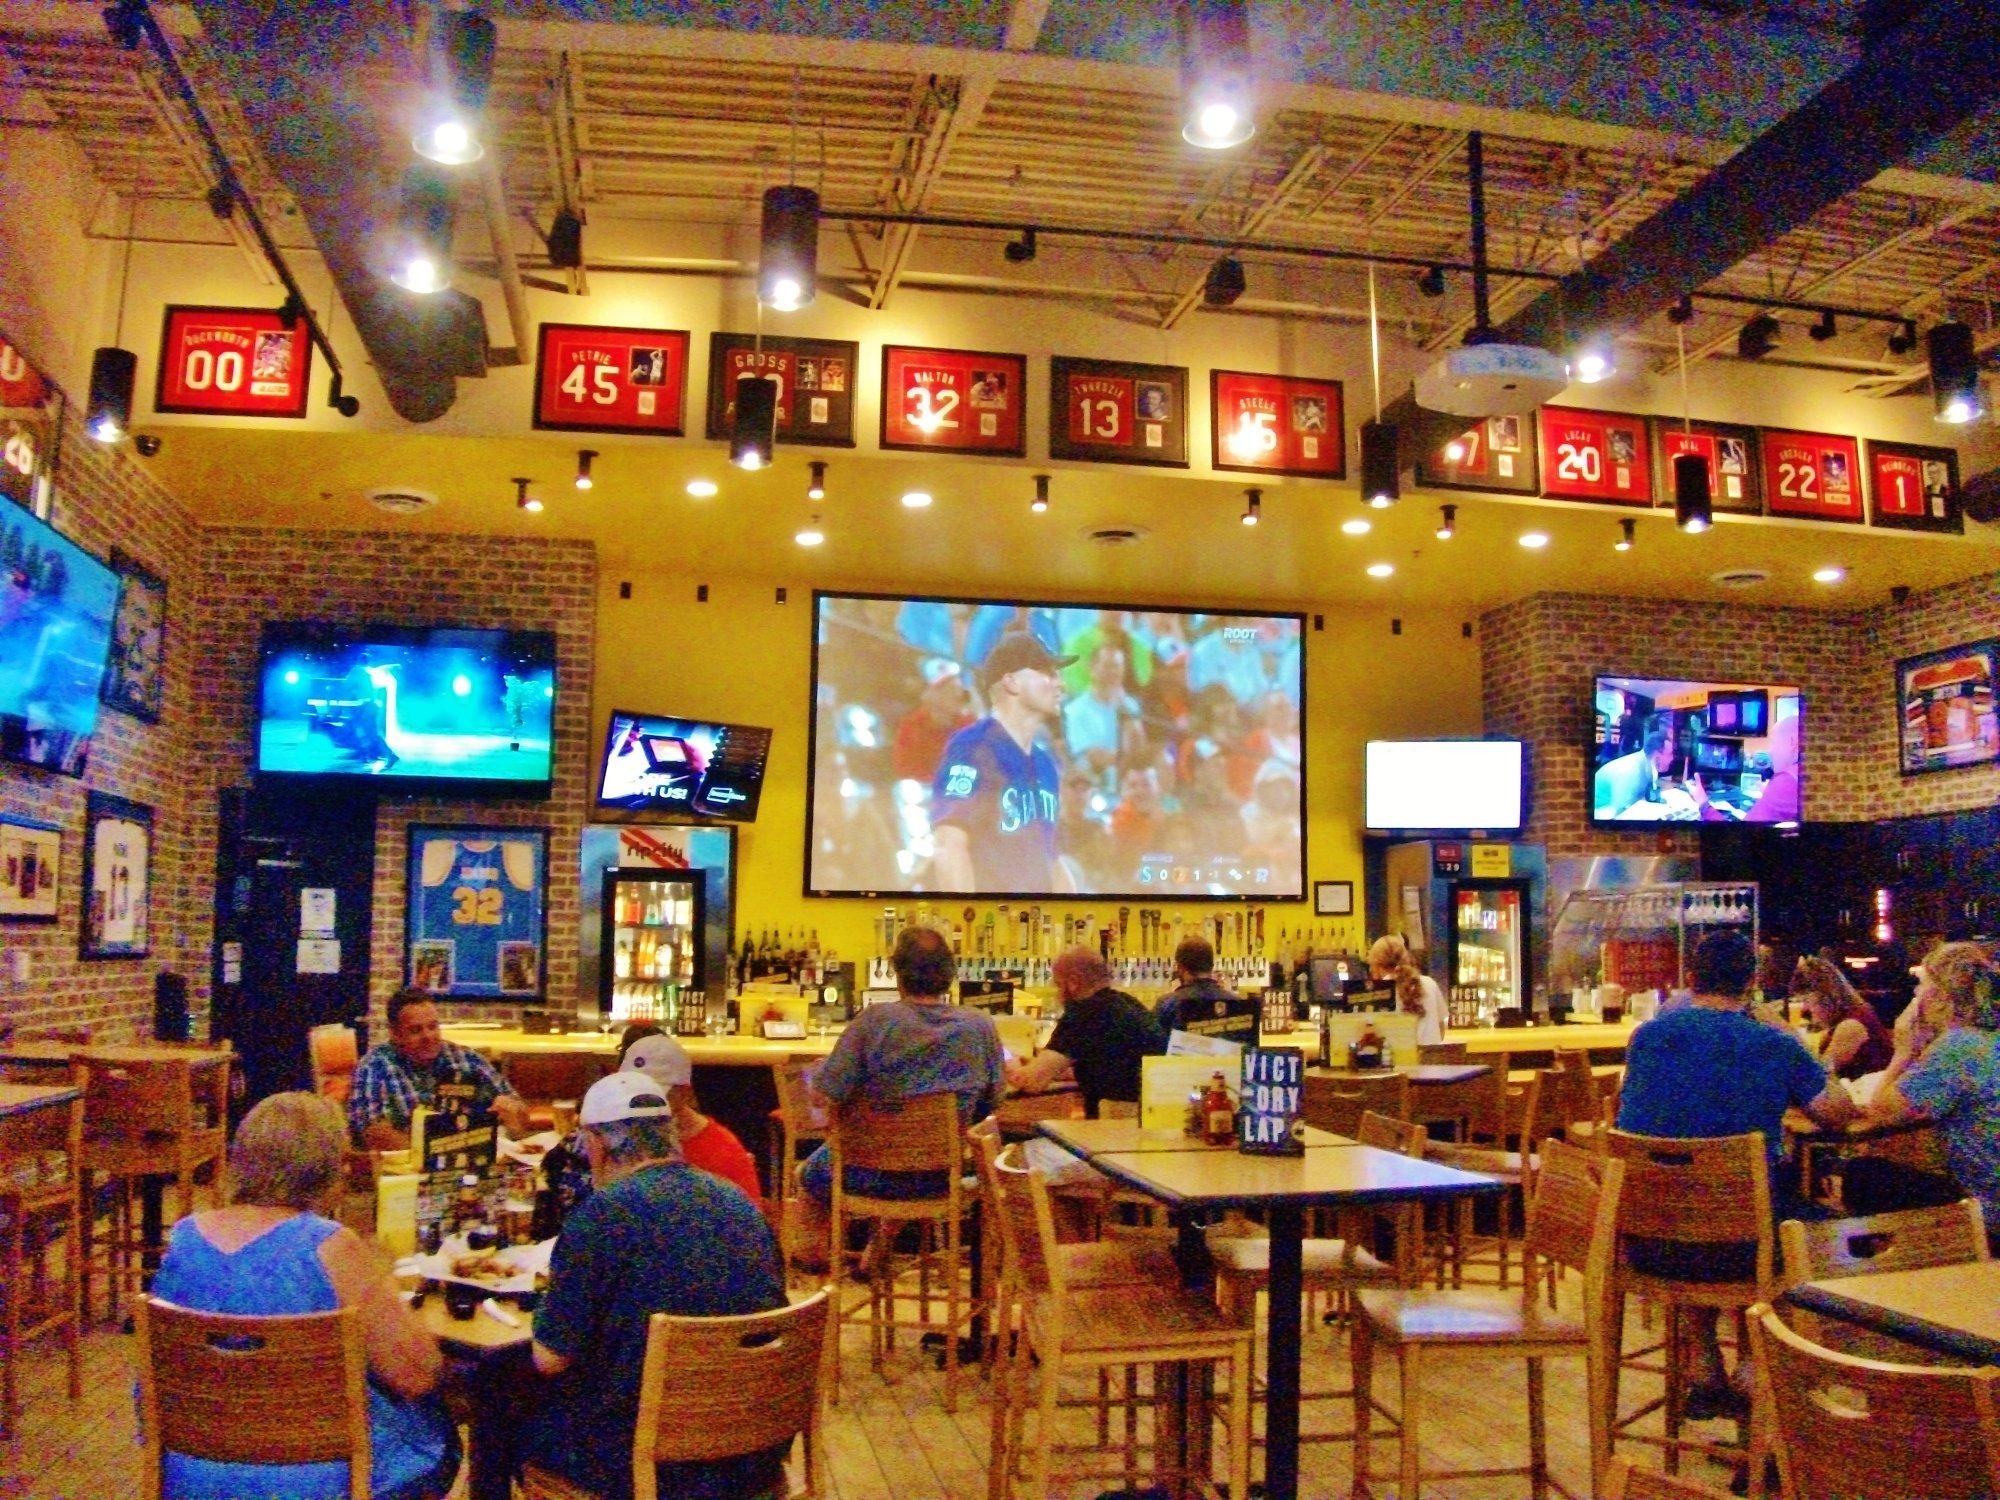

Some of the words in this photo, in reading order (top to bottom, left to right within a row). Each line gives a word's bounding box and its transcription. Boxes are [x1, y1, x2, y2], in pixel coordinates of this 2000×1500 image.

[185, 349, 243, 391] 00
[571, 350, 612, 365] PETRIE
[735, 353, 787, 371] GROSS
[561, 364, 620, 405] 45
[913, 371, 955, 385] WALTON
[906, 386, 960, 433] 32
[1080, 398, 1119, 438] 13
[1564, 430, 1592, 443] LUCAS
[1557, 443, 1600, 482] 20
[1778, 463, 1818, 499] 22
[1896, 476, 1906, 509] 1
[1223, 627, 1258, 639] ROOT
[659, 786, 688, 800] US!
[1159, 869, 1168, 881] 0
[1194, 870, 1200, 881] 1
[452, 886, 505, 925] 32
[1244, 1053, 1299, 1083] VICT
[1244, 1115, 1285, 1143] LAP
